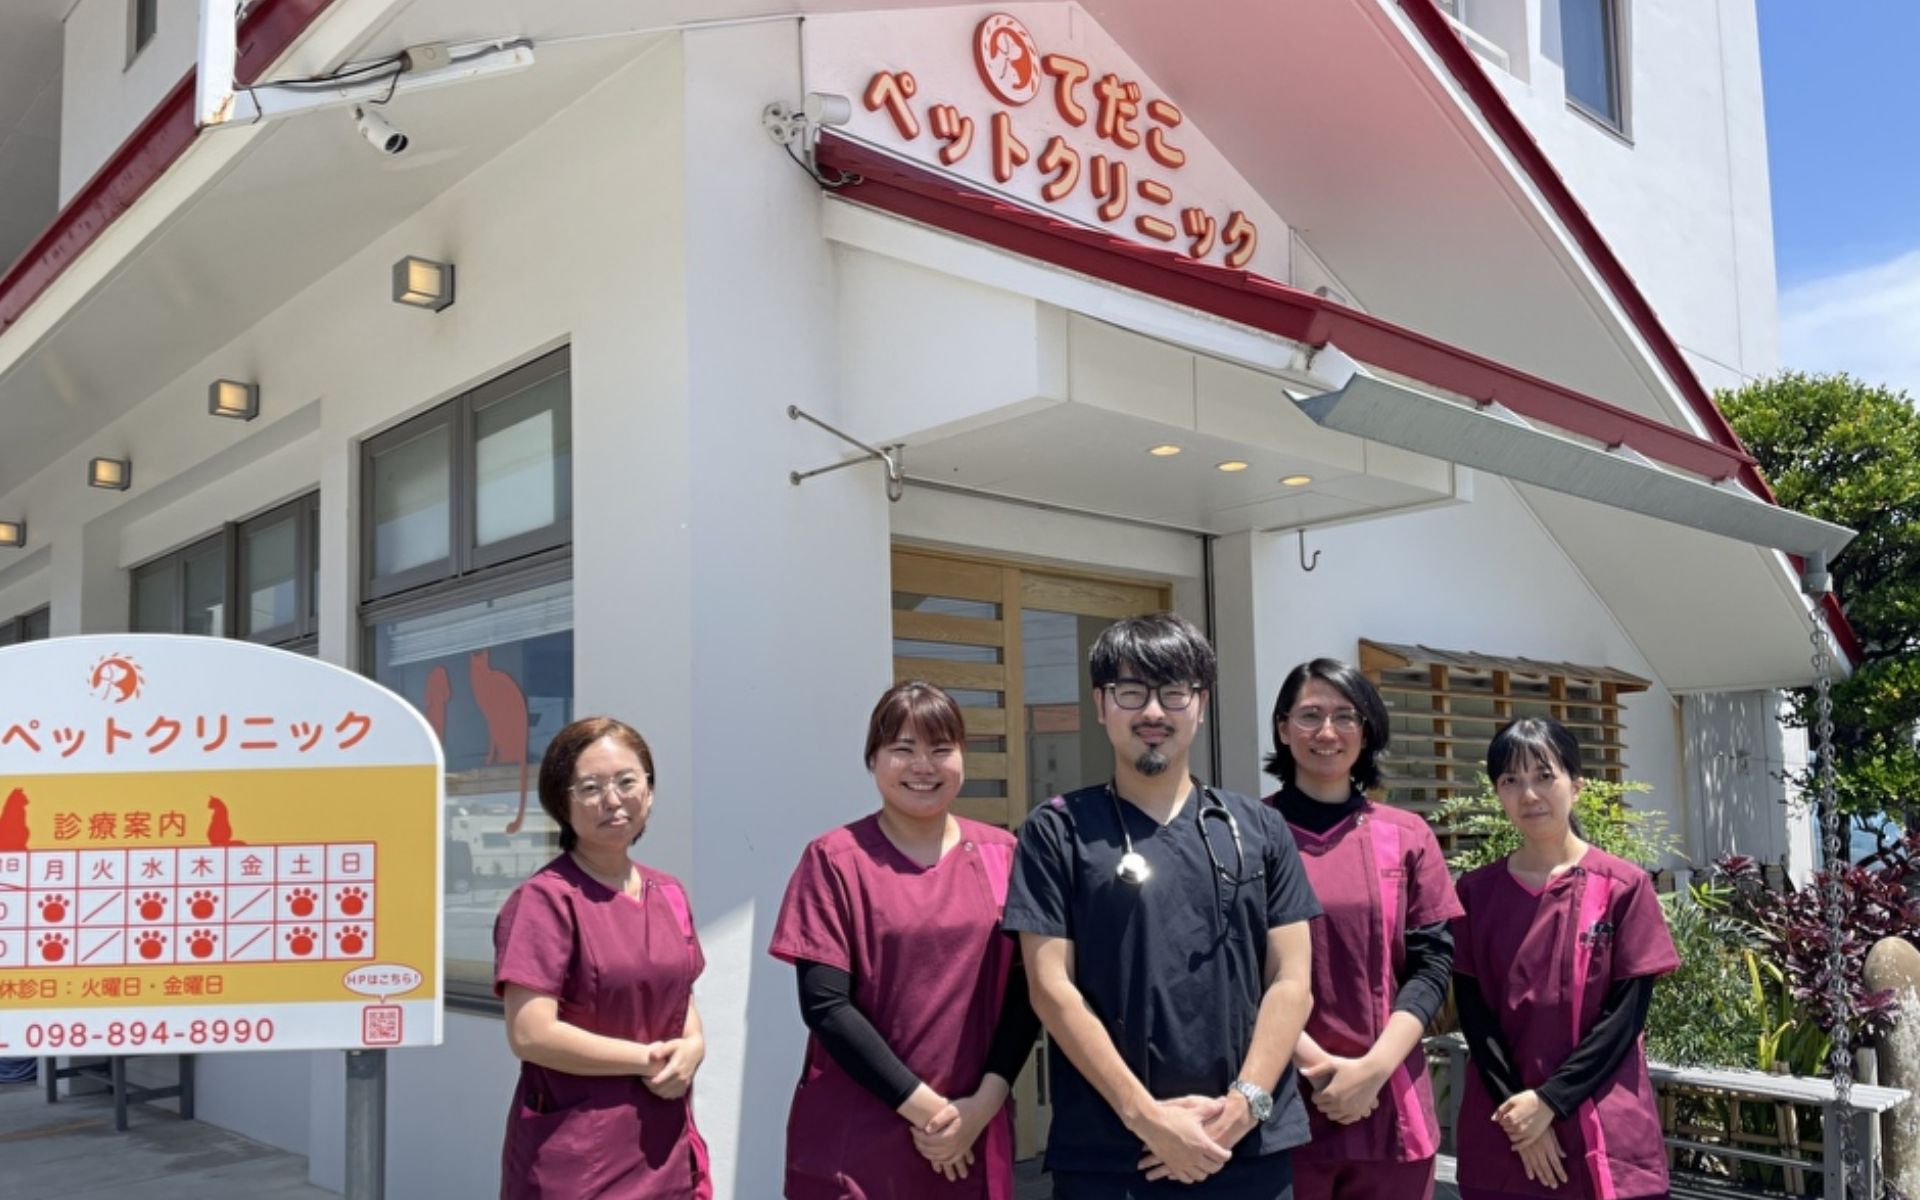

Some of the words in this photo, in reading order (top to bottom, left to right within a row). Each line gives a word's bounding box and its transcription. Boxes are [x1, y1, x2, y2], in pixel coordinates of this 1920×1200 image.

[1042, 53, 1184, 168] てだこ
[864, 70, 1257, 268] ペットクリニック
[2, 711, 372, 757] ペットクリニック
[53, 811, 187, 840] 診療案内
[44, 859, 64, 881] 月
[92, 858, 114, 880] 火
[141, 857, 164, 878] 水
[191, 855, 214, 877] 木
[240, 853, 264, 876] 金
[290, 853, 313, 875] 土
[341, 852, 360, 873] 日
[25, 1018, 274, 1048] 098-894-8990
